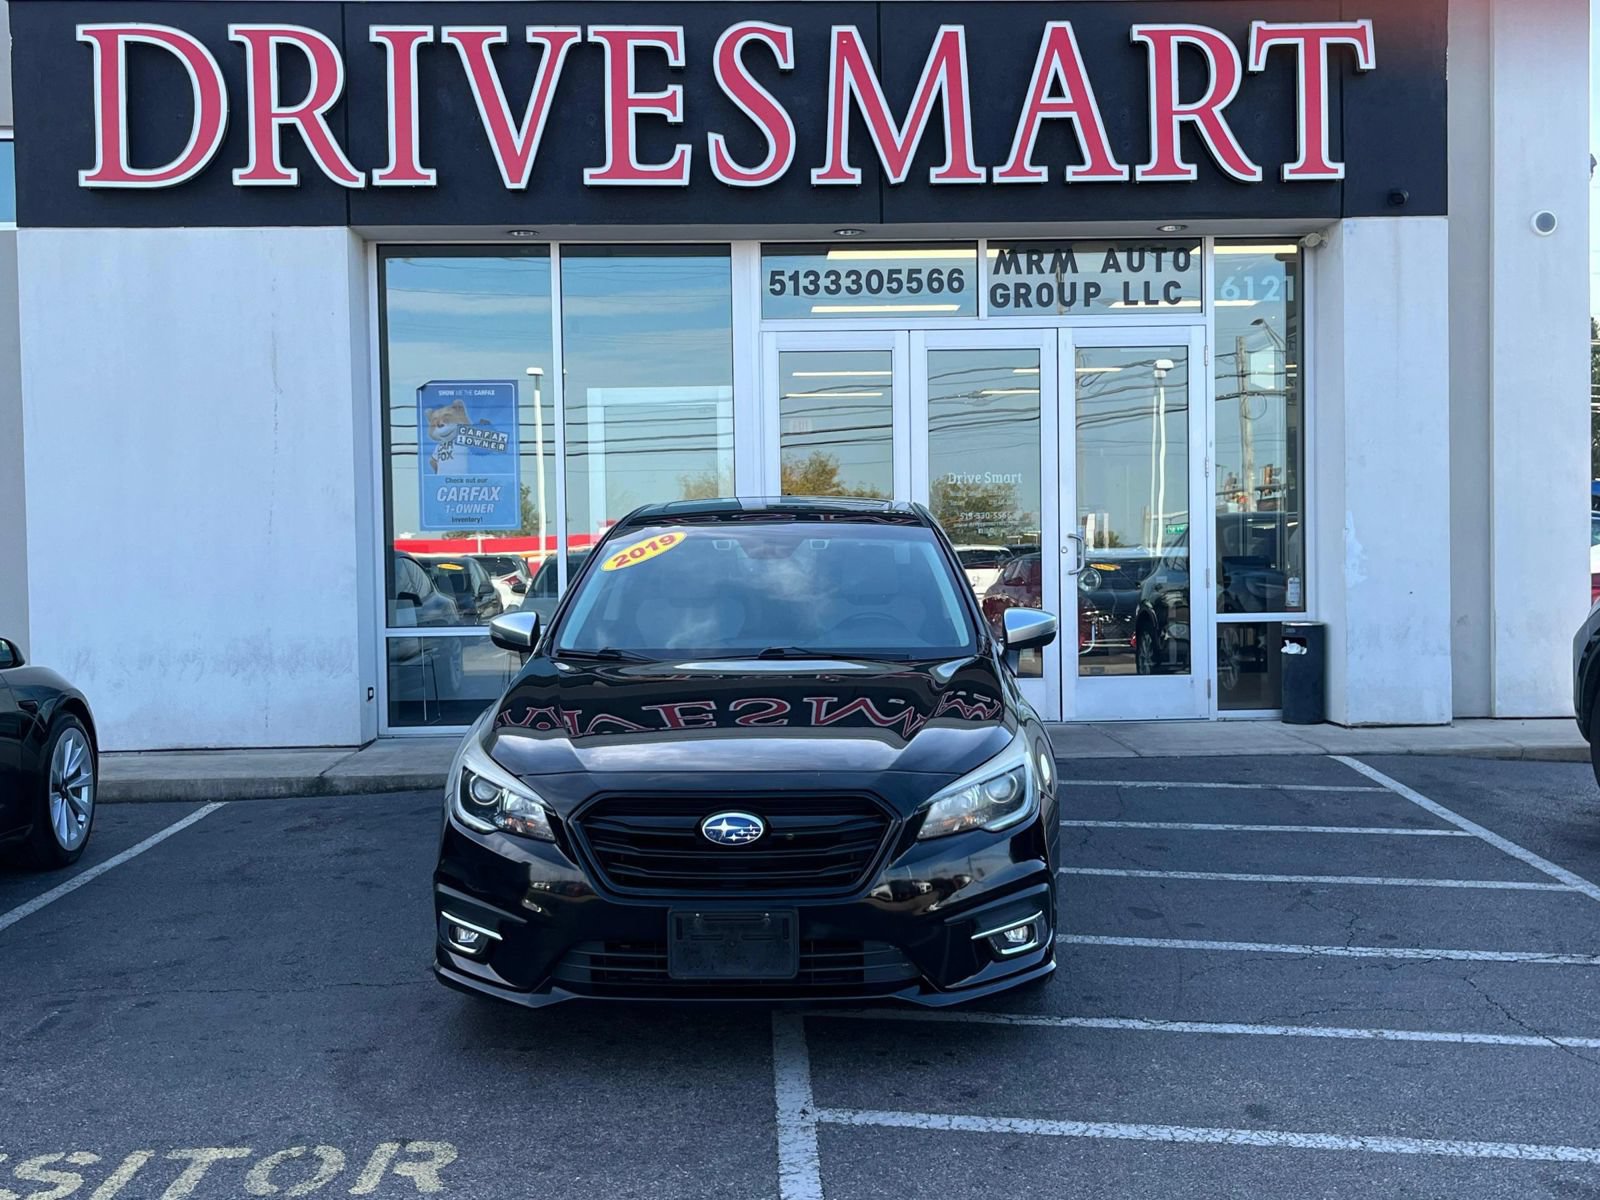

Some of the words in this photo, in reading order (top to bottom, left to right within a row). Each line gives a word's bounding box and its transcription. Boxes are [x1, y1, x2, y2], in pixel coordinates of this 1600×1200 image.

[75, 19, 1377, 190] DRIVESMART
[993, 248, 1078, 275] MRM
[1102, 247, 1191, 273] AUTO
[769, 268, 965, 297] 5133305566
[990, 281, 1101, 309] GROUP
[1123, 280, 1183, 305] LLC
[1220, 275, 1294, 301] 6121
[459, 427, 508, 442] CARFAX
[437, 451, 453, 462] FOX
[948, 472, 981, 484] Drive
[984, 472, 1022, 484] Smart
[437, 487, 501, 502] CARFAX
[445, 504, 495, 514] 1-OWNER
[613, 535, 676, 568] 2019
[0, 1141, 459, 1200] SITOR
